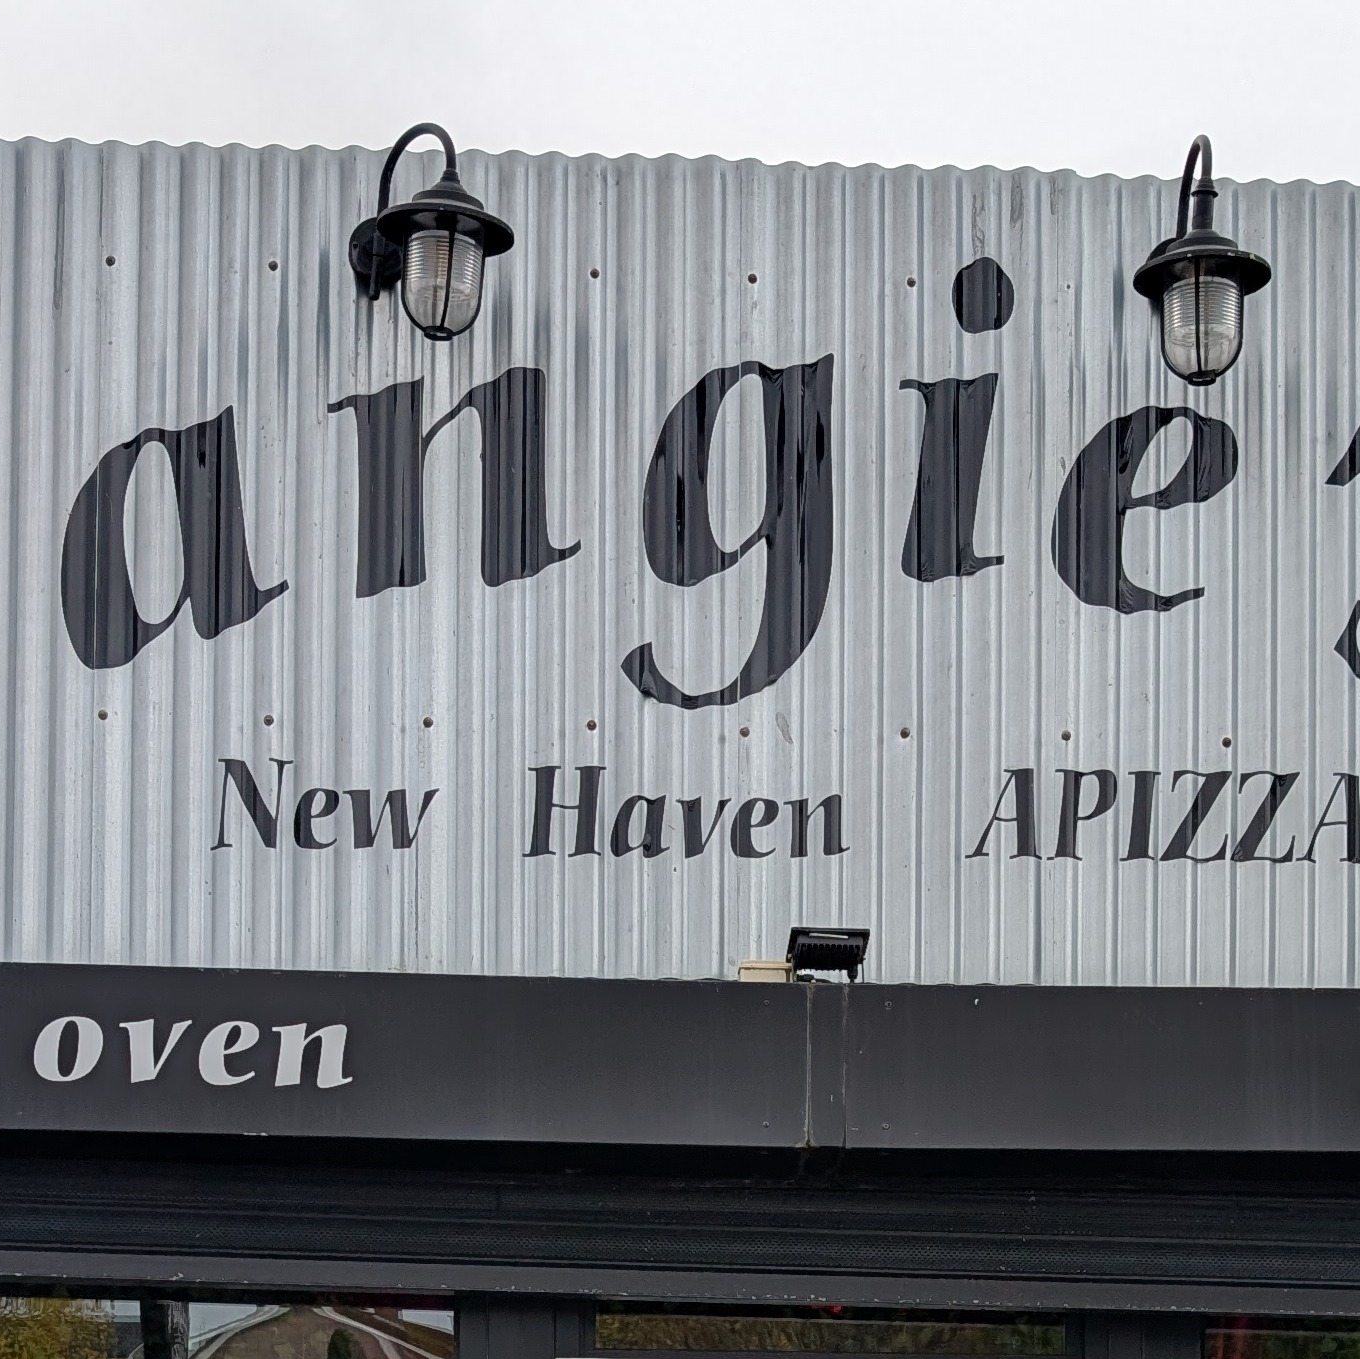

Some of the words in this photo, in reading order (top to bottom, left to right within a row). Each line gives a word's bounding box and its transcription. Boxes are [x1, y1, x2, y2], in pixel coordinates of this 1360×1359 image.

[212, 756, 441, 858] New
[520, 764, 851, 862] Haven
[31, 1013, 354, 1089] oven
